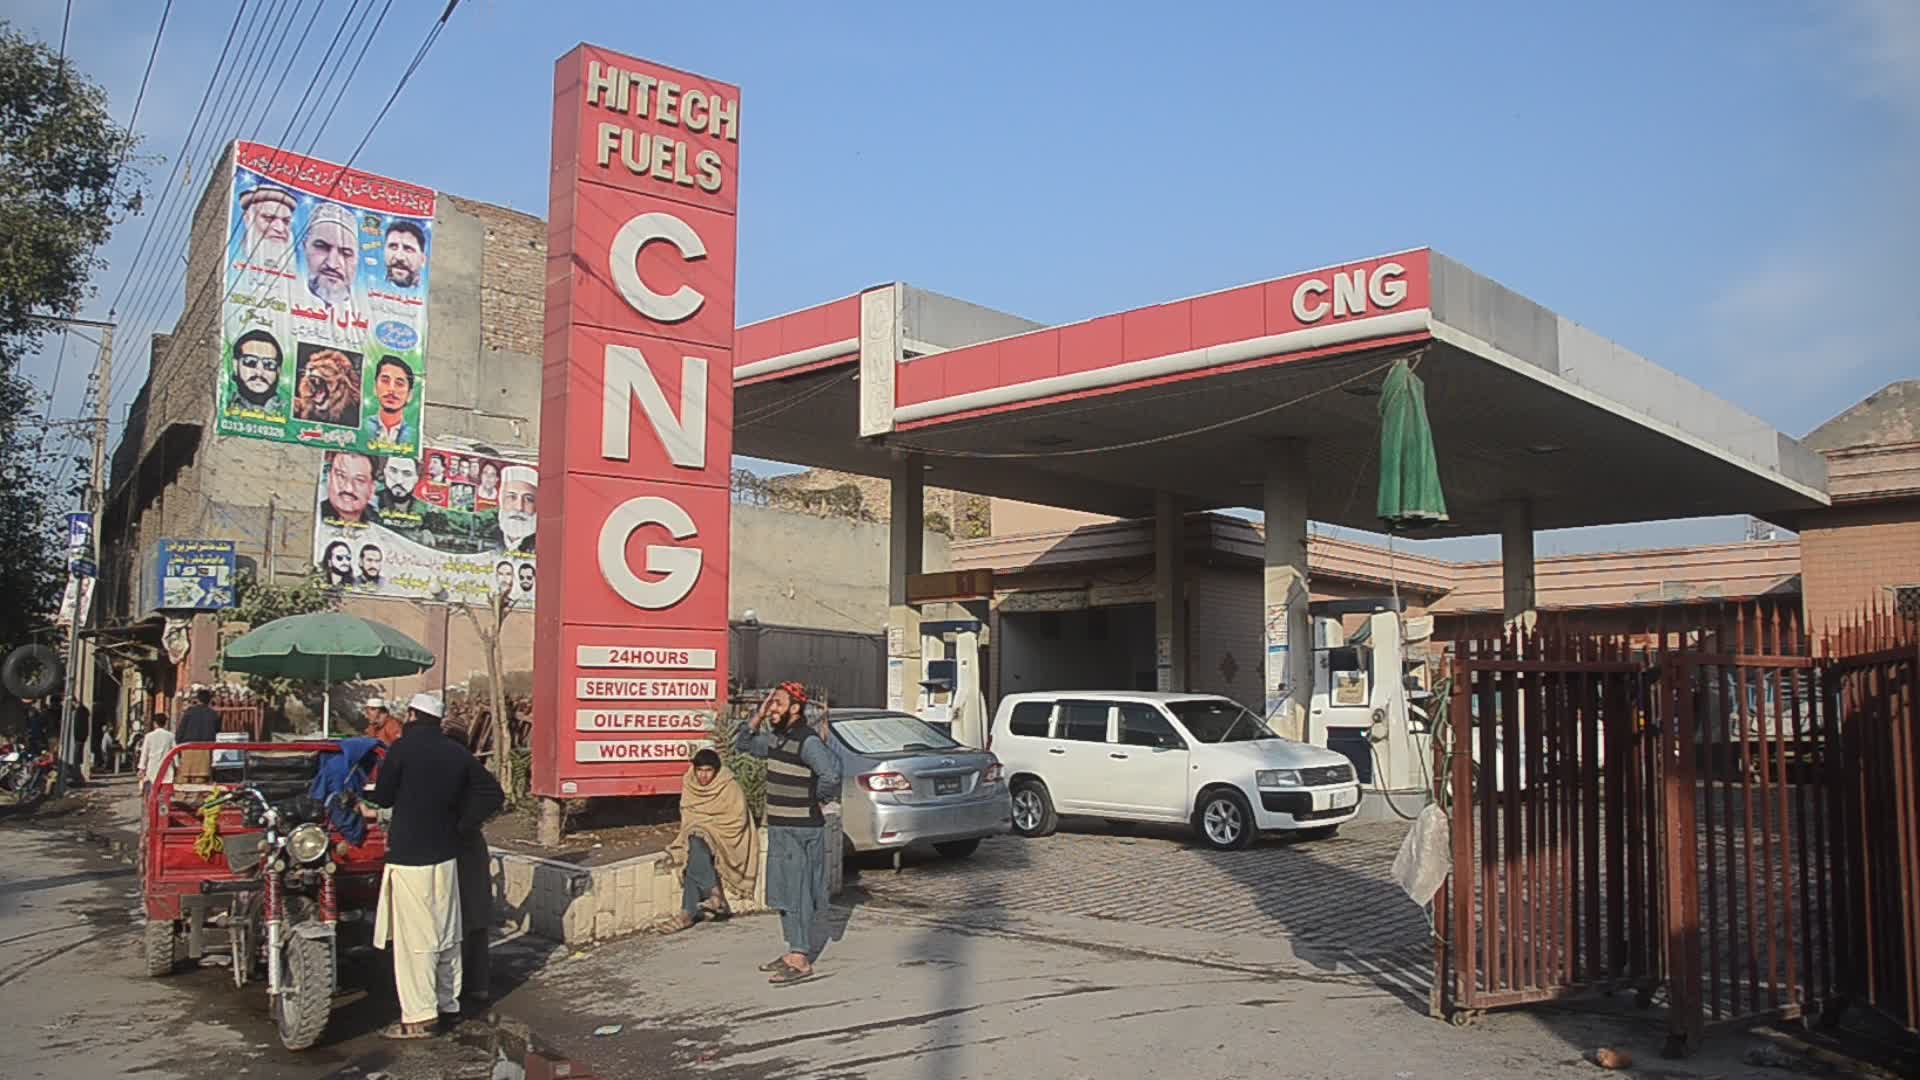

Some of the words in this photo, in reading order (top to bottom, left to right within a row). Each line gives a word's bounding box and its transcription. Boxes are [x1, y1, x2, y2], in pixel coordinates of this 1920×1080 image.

[586, 60, 738, 142] HITECH
[597, 122, 722, 191] FUELS
[1292, 262, 1408, 324] CNG
[609, 650, 689, 665] 24HOURS
[586, 681, 648, 696] SERVICE
[651, 682, 710, 697] STATION
[594, 713, 704, 728] OILFREEGAS
